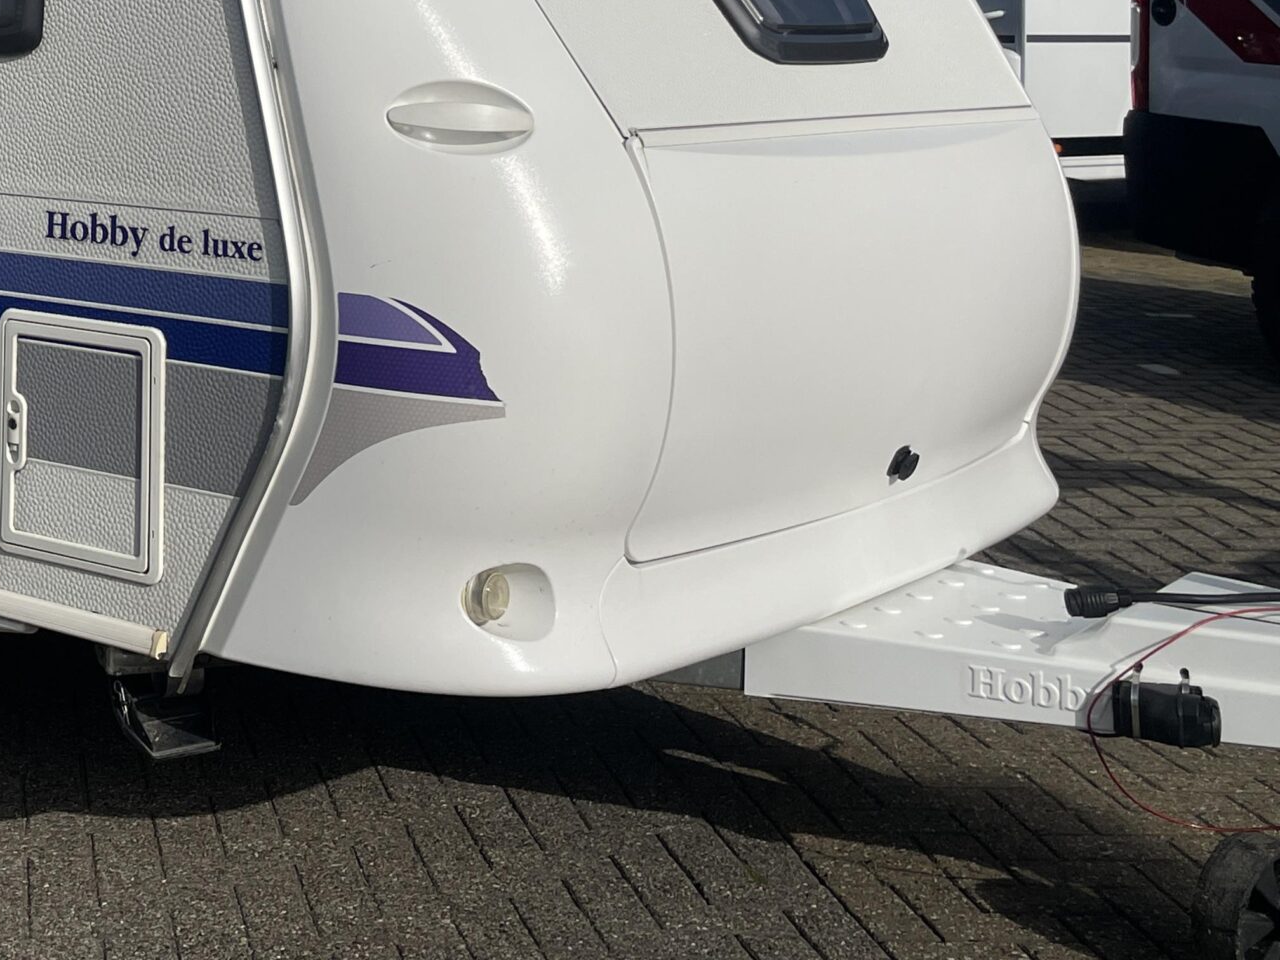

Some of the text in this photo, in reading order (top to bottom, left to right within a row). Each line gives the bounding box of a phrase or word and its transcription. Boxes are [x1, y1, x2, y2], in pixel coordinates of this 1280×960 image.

[45, 210, 263, 262] Hobby de luxe
[968, 664, 1091, 712] Hobb
